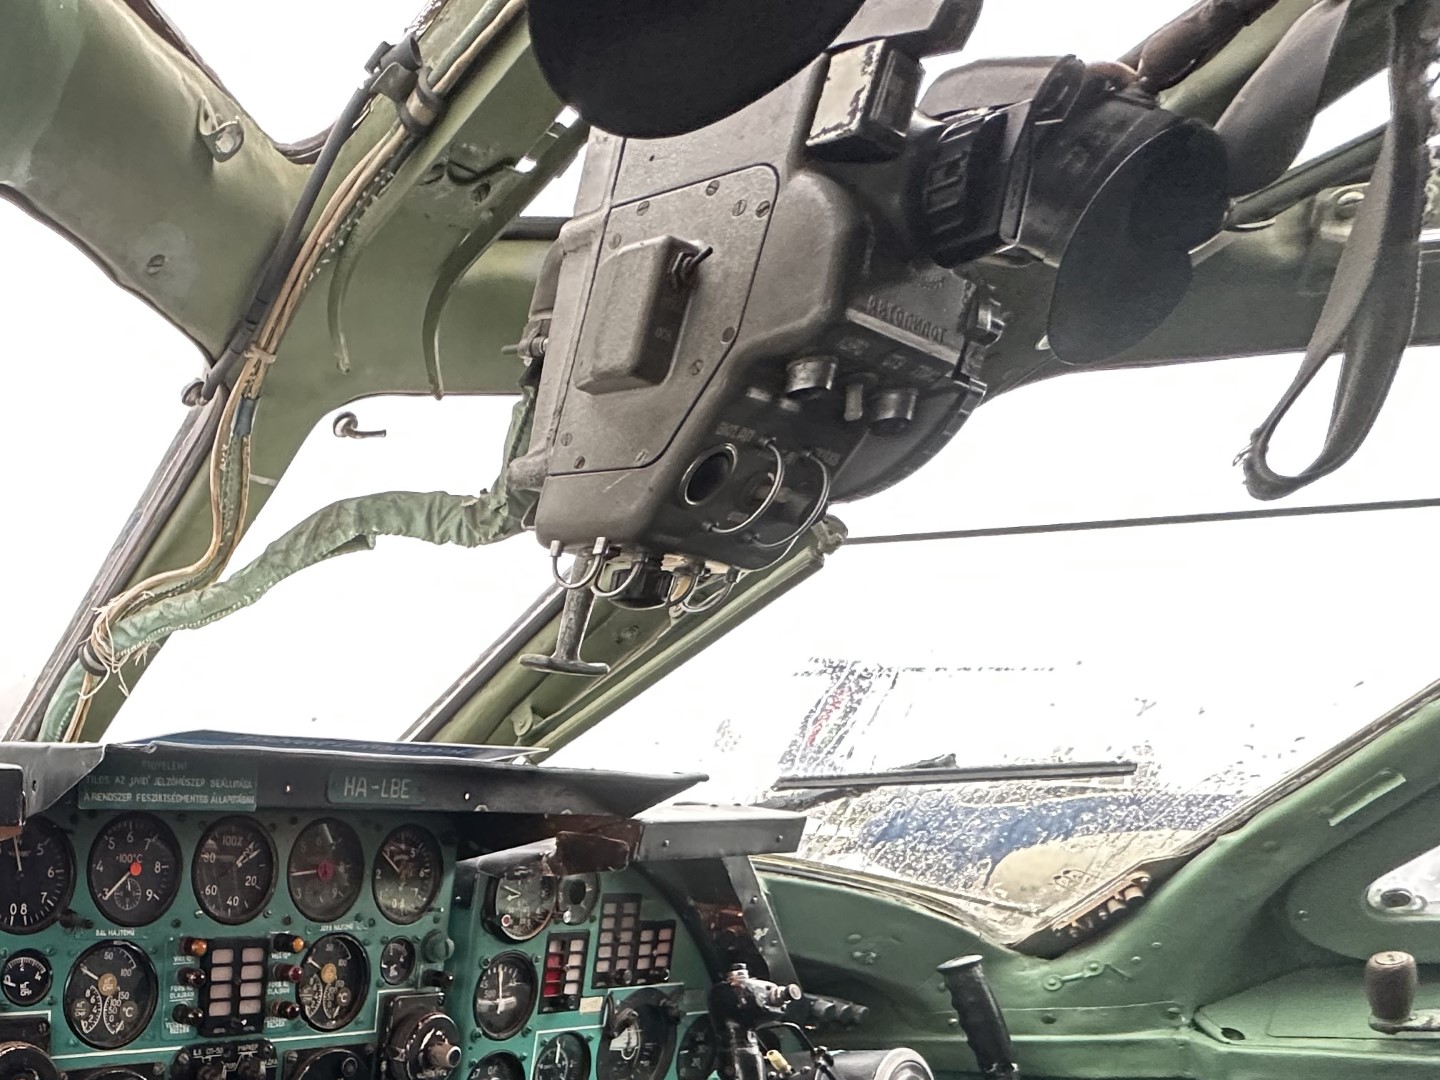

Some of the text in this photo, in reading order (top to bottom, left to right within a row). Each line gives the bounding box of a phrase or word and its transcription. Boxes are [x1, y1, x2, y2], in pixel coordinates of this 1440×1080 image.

[126, 831, 134, 843] 6
[47, 867, 55, 878] 6
[154, 862, 161, 874] 8
[145, 889, 153, 901] 9
[20, 903, 27, 915] 8
